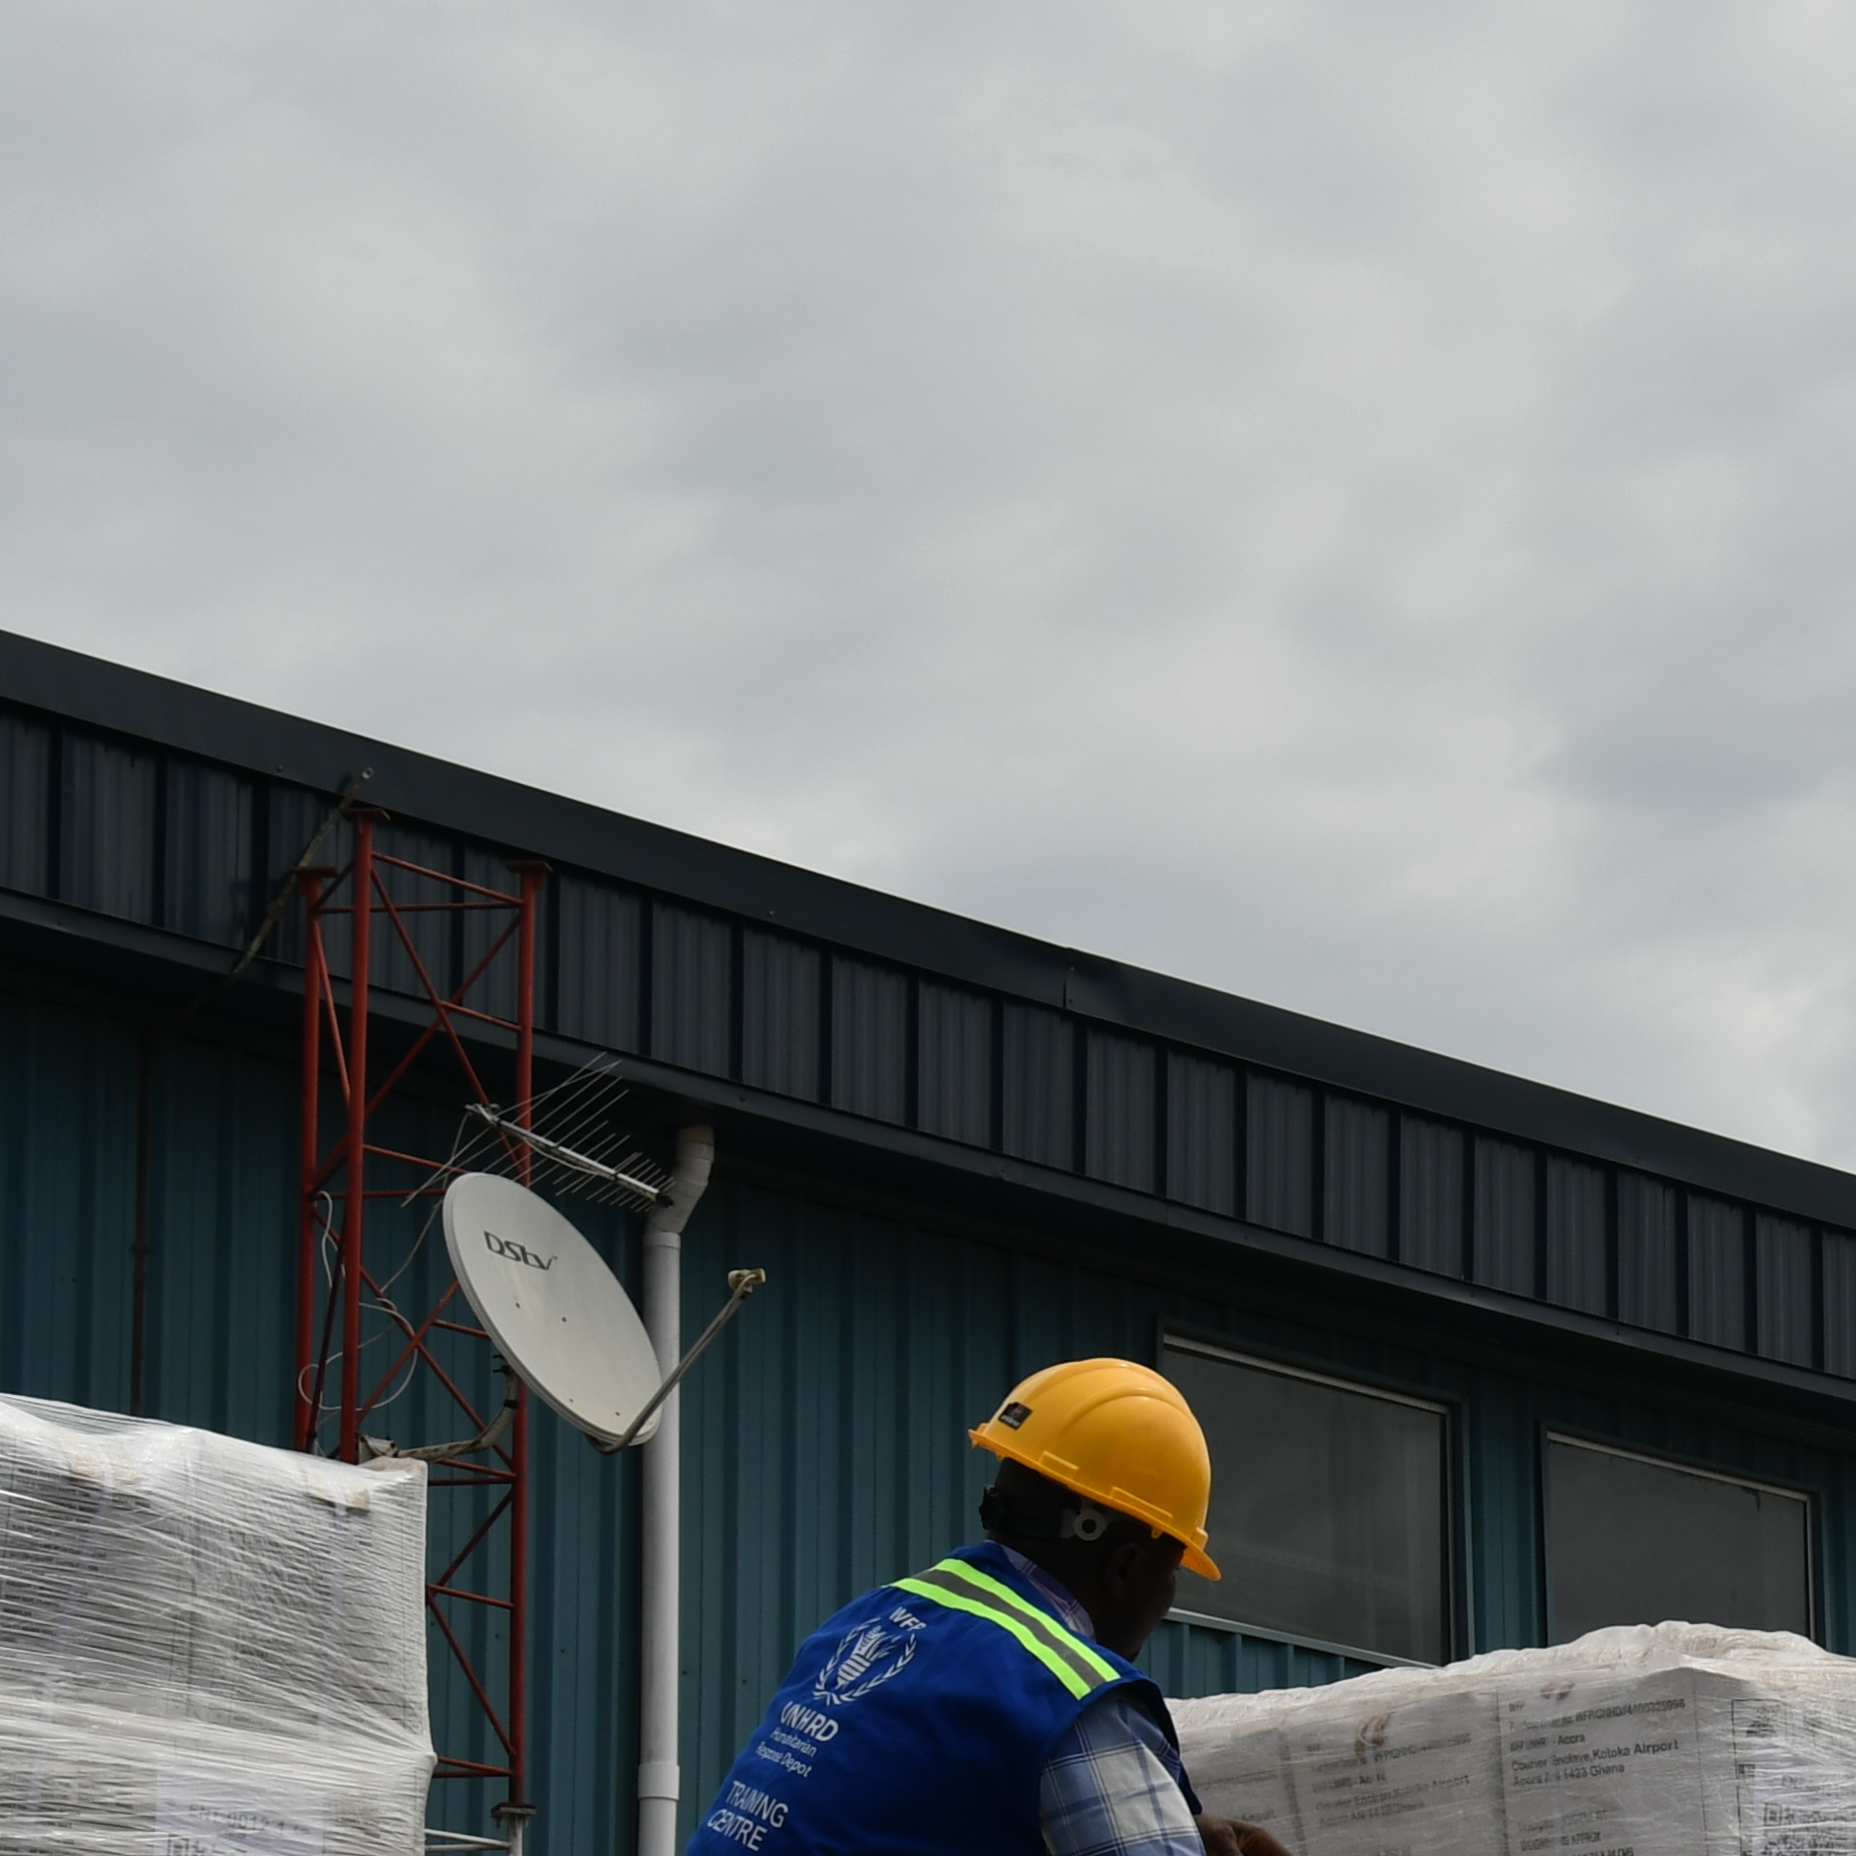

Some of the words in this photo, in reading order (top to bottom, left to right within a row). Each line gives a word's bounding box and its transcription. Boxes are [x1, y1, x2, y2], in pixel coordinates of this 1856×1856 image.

[889, 1606, 927, 1631] WFP
[781, 1701, 839, 1742] UNHRD
[1558, 1734, 1586, 1746] Accra
[1634, 1739, 1679, 1756] Airport
[780, 1752, 813, 1777] Depot
[1590, 1764, 1625, 1777] Ghana
[725, 1780, 789, 1828] TRAINING
[707, 1808, 768, 1851] CENTRE
